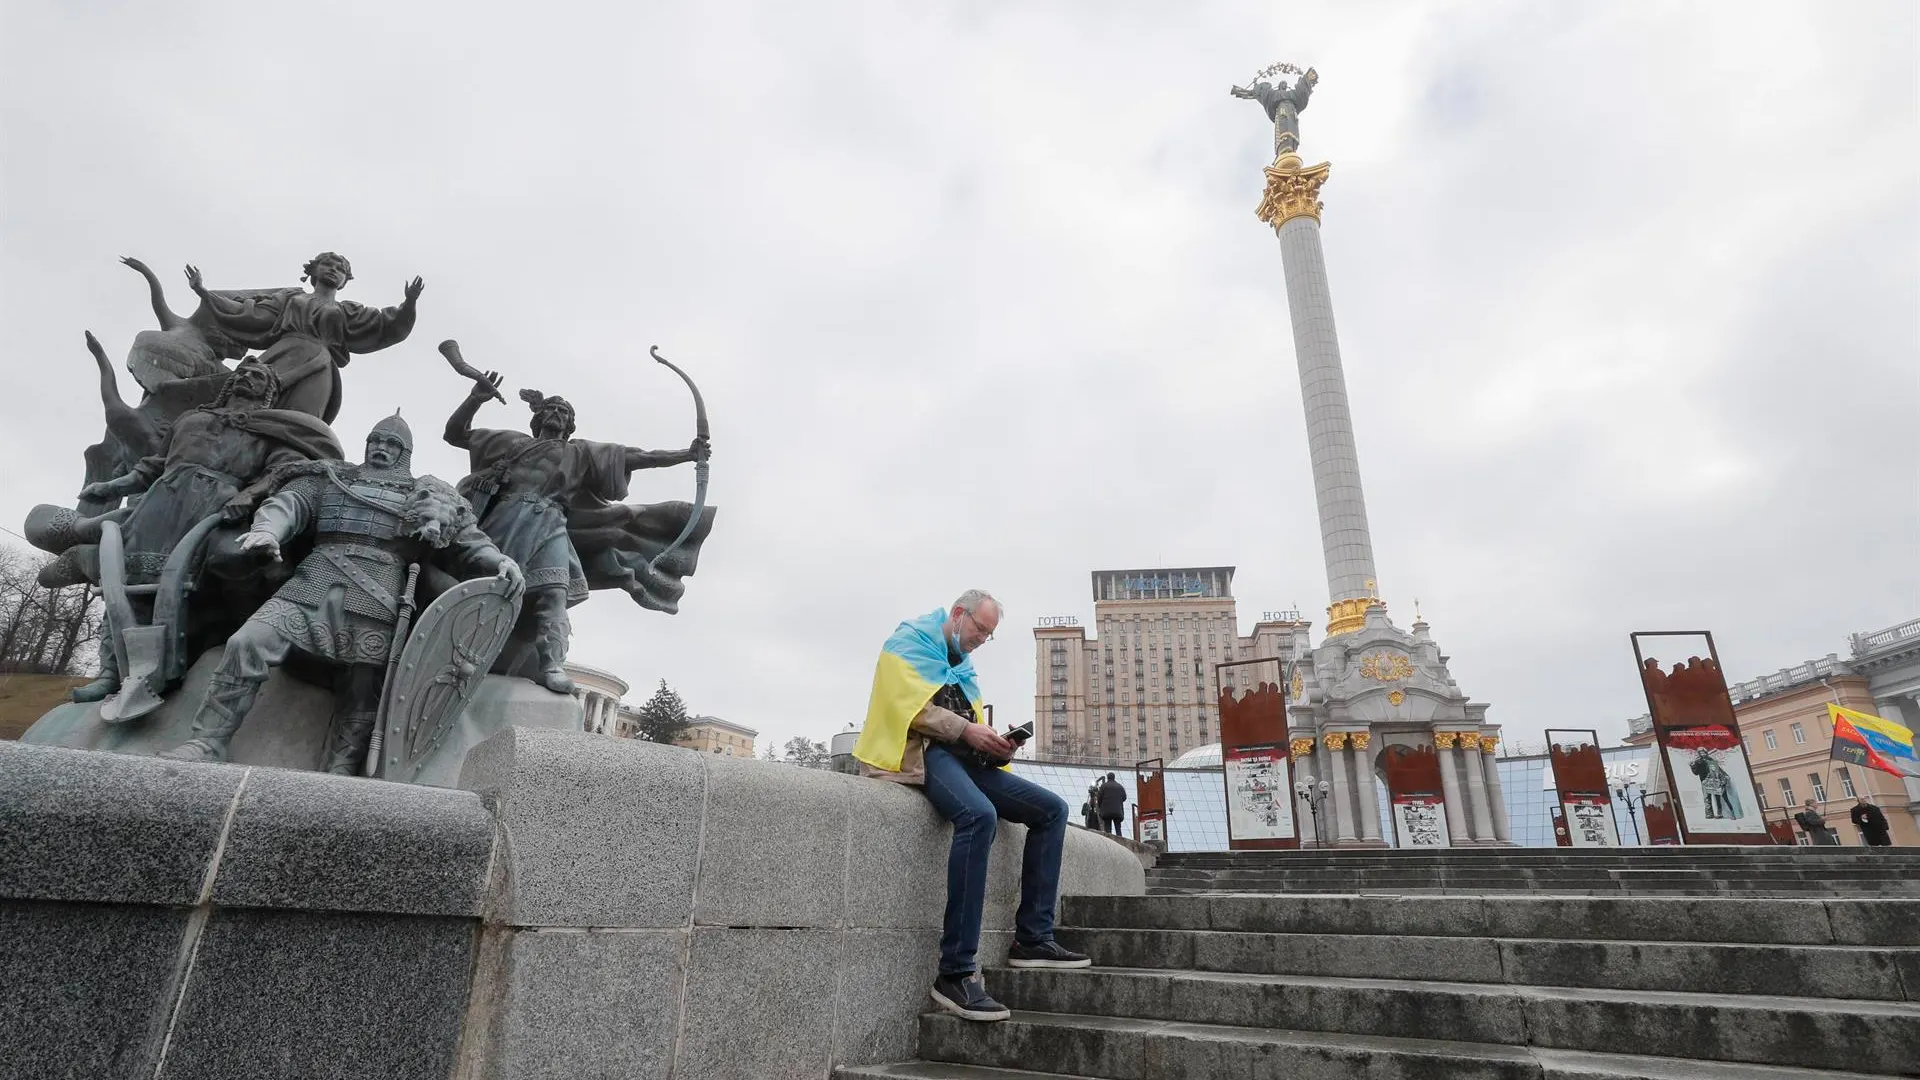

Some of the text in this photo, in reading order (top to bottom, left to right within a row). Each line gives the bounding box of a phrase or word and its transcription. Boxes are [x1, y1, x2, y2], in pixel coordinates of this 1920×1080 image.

[1038, 615, 1079, 626] ГОТЕЛЬ
[1263, 610, 1304, 621] HOTEL
[1603, 762, 1640, 780] BUS
